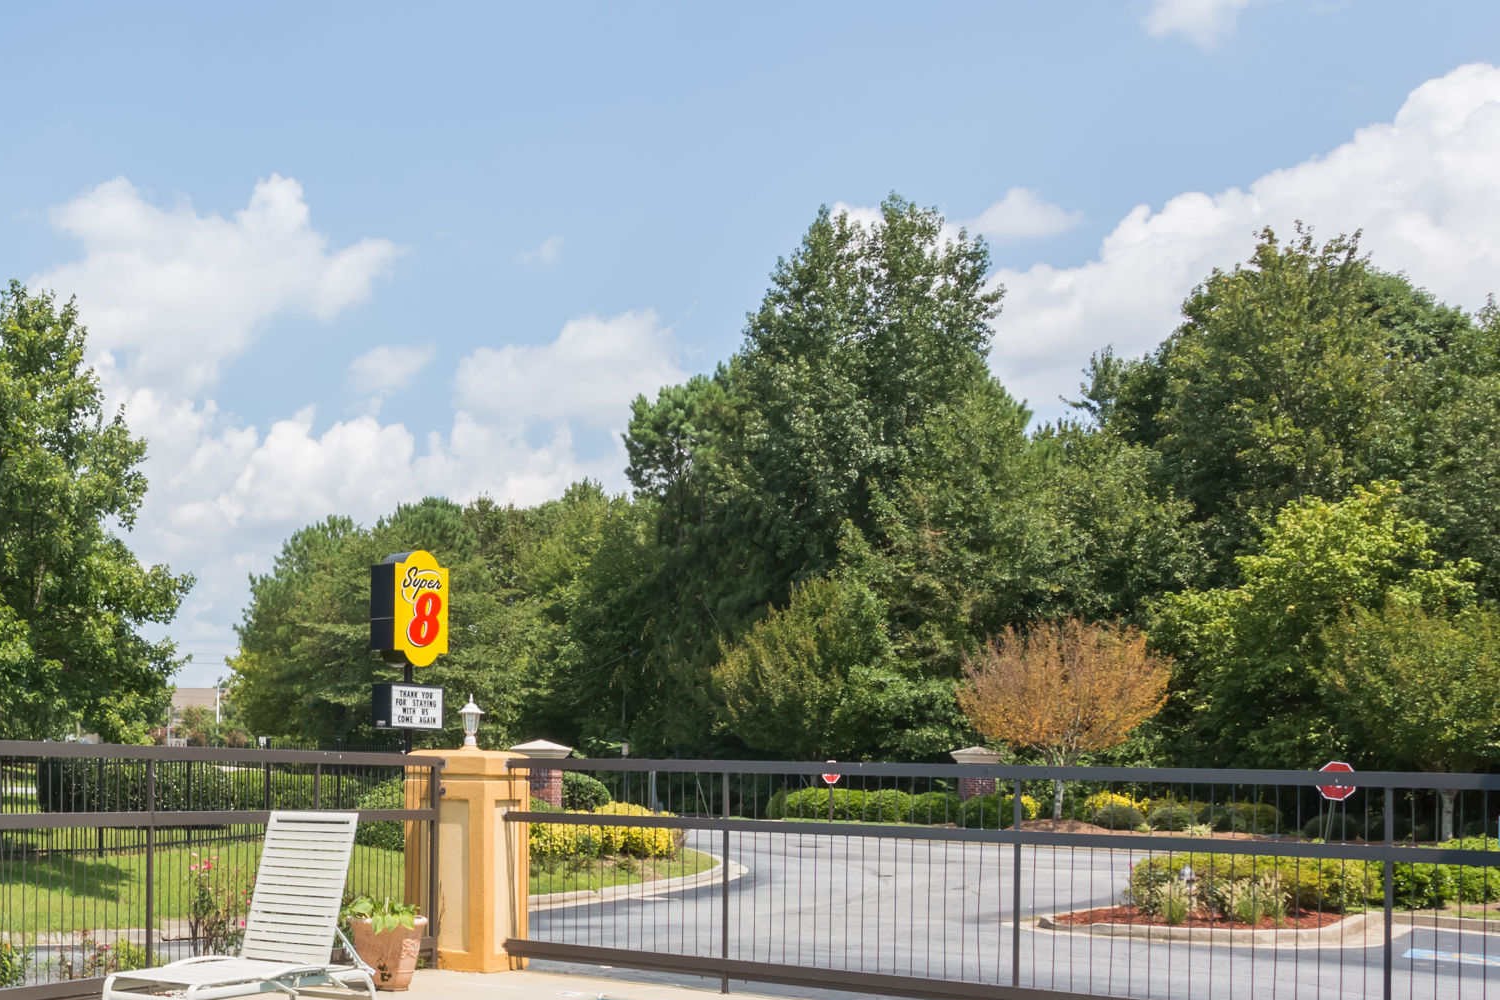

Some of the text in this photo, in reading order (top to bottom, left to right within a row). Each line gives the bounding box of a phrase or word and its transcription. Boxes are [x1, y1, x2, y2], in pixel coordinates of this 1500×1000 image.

[403, 567, 442, 600] Super
[408, 592, 442, 646] 8
[400, 690, 418, 698] THANK
